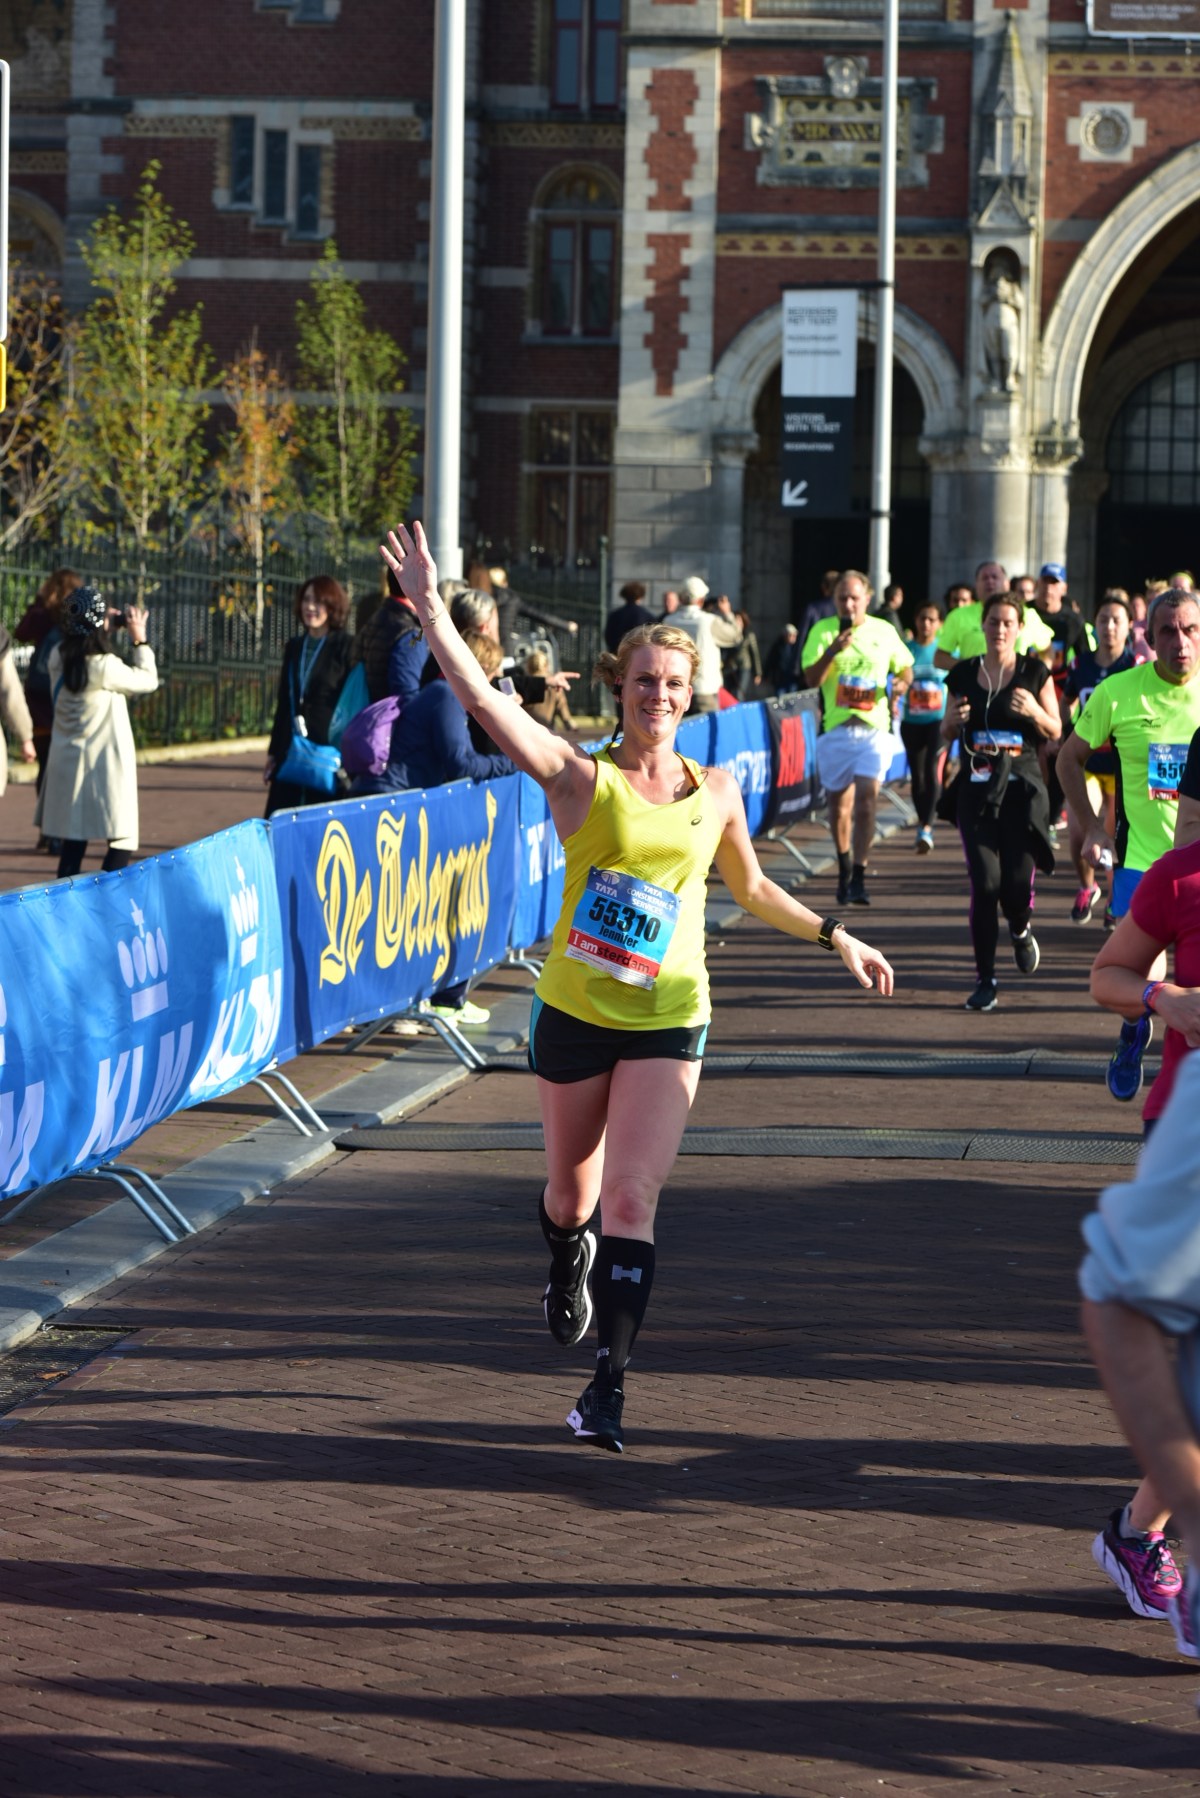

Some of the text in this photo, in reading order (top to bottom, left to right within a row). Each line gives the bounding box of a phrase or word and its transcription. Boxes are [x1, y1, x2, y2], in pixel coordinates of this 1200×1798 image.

[1155, 753, 1173, 761] TATA
[595, 883, 618, 897] TATA
[626, 888, 674, 911] CONSULTANCY
[643, 886, 662, 897] TATA
[316, 819, 373, 990] De
[588, 896, 661, 942] 55310
[573, 933, 579, 946] I
[598, 925, 639, 948] Jennifer
[190, 968, 282, 1096] KLM
[73, 1021, 194, 1167] KLM
